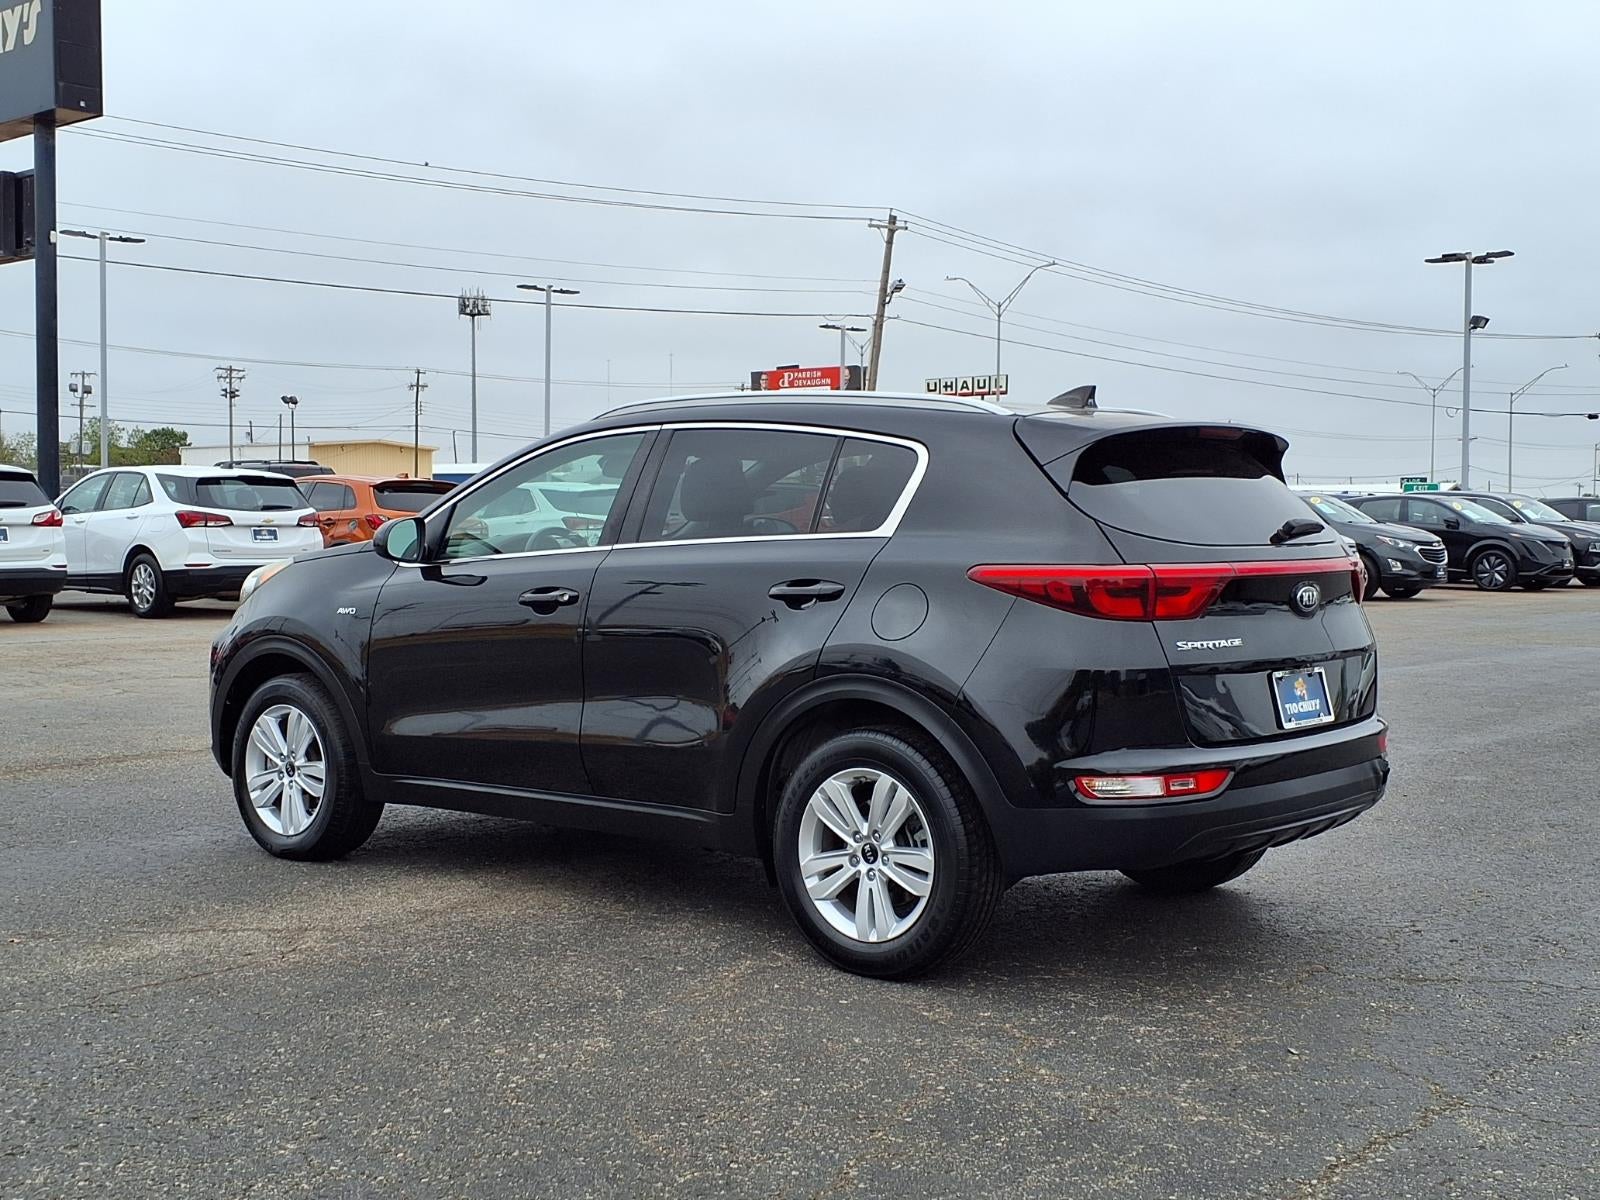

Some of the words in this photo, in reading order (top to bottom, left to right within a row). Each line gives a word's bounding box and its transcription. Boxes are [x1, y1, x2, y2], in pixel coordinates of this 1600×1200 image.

[0, 0, 41, 53] Y'S
[794, 378, 831, 386] DEVAUGHN
[1302, 591, 1317, 605] KIA
[336, 607, 356, 615] AWD
[1176, 637, 1243, 650] SPORTAGE
[864, 844, 874, 864] KIA
